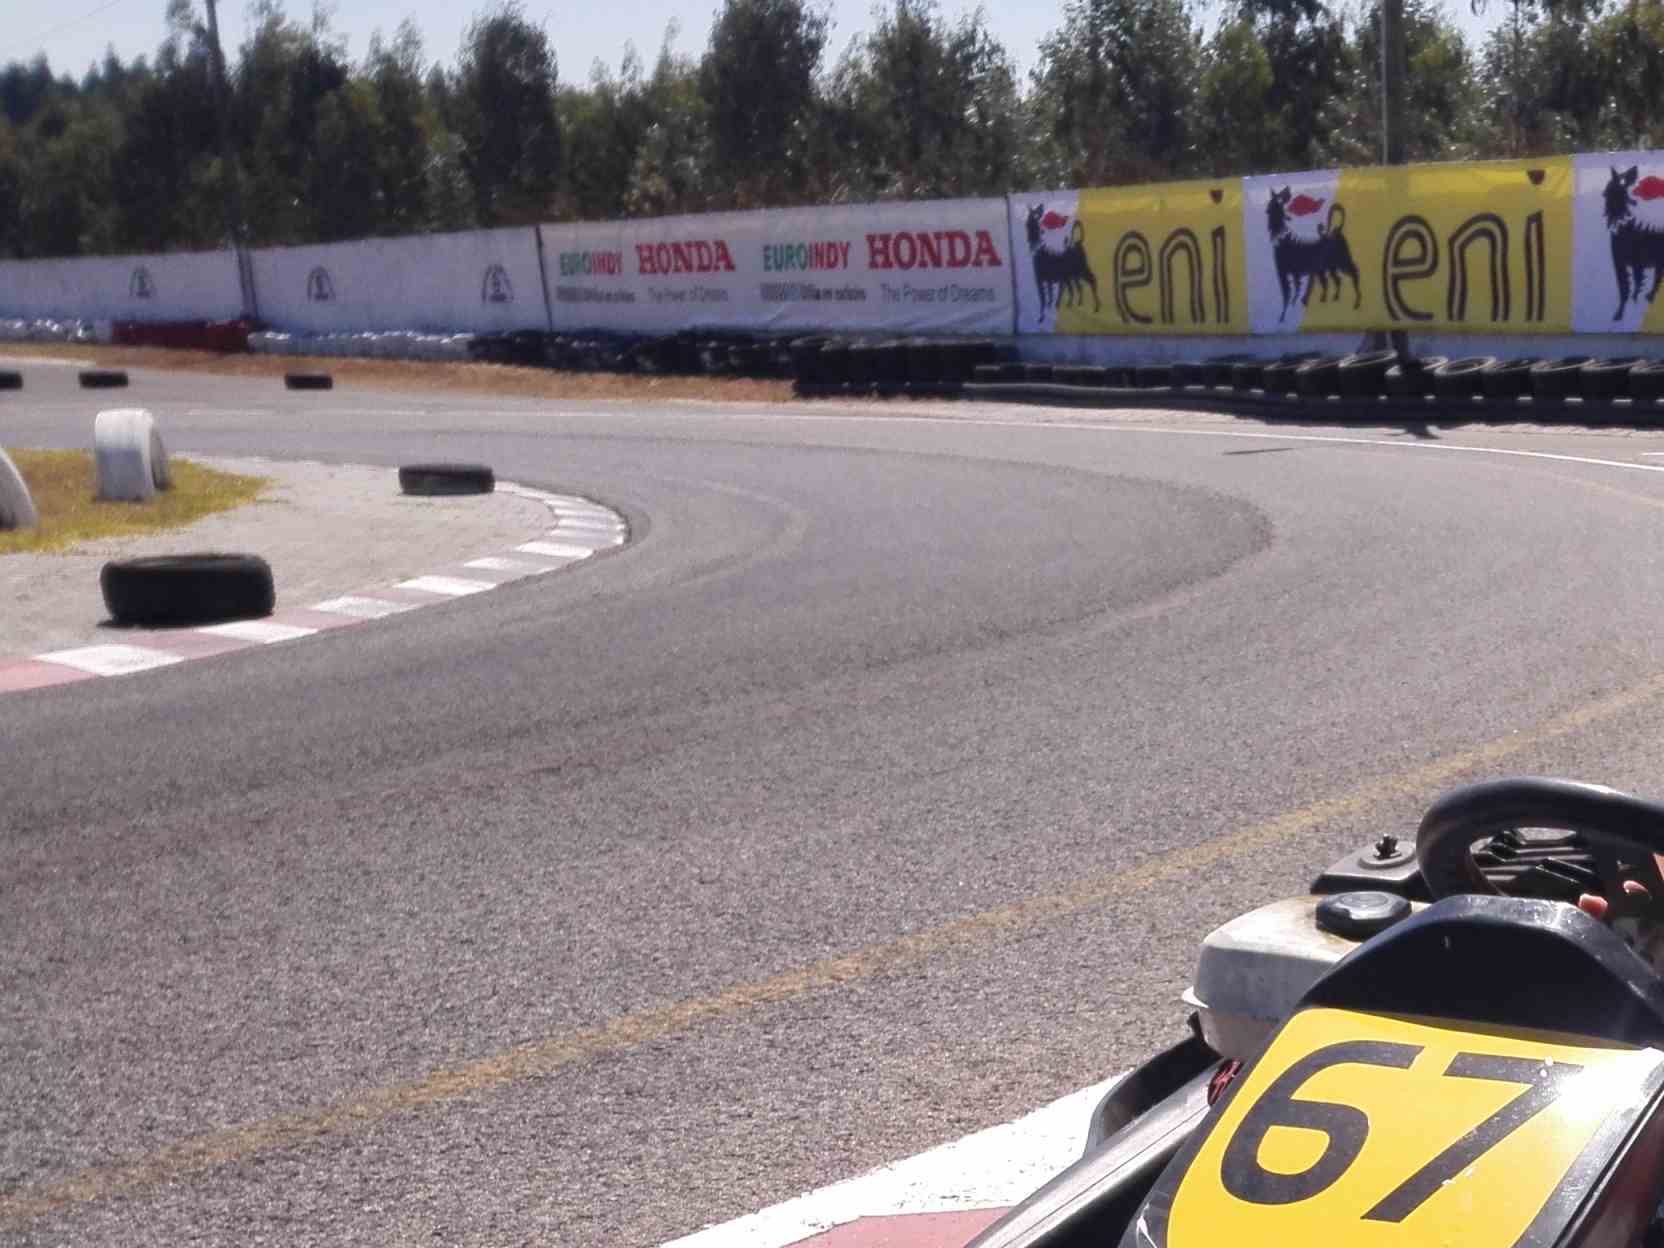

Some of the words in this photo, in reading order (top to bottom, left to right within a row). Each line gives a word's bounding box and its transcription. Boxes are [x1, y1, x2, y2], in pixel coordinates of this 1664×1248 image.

[635, 239, 737, 275] HONDA
[763, 241, 851, 272] EUROINDY
[865, 229, 1003, 270] HONDA
[1113, 189, 1230, 324] eni
[1382, 169, 1546, 322] eni
[1220, 1039, 1585, 1223] 67
